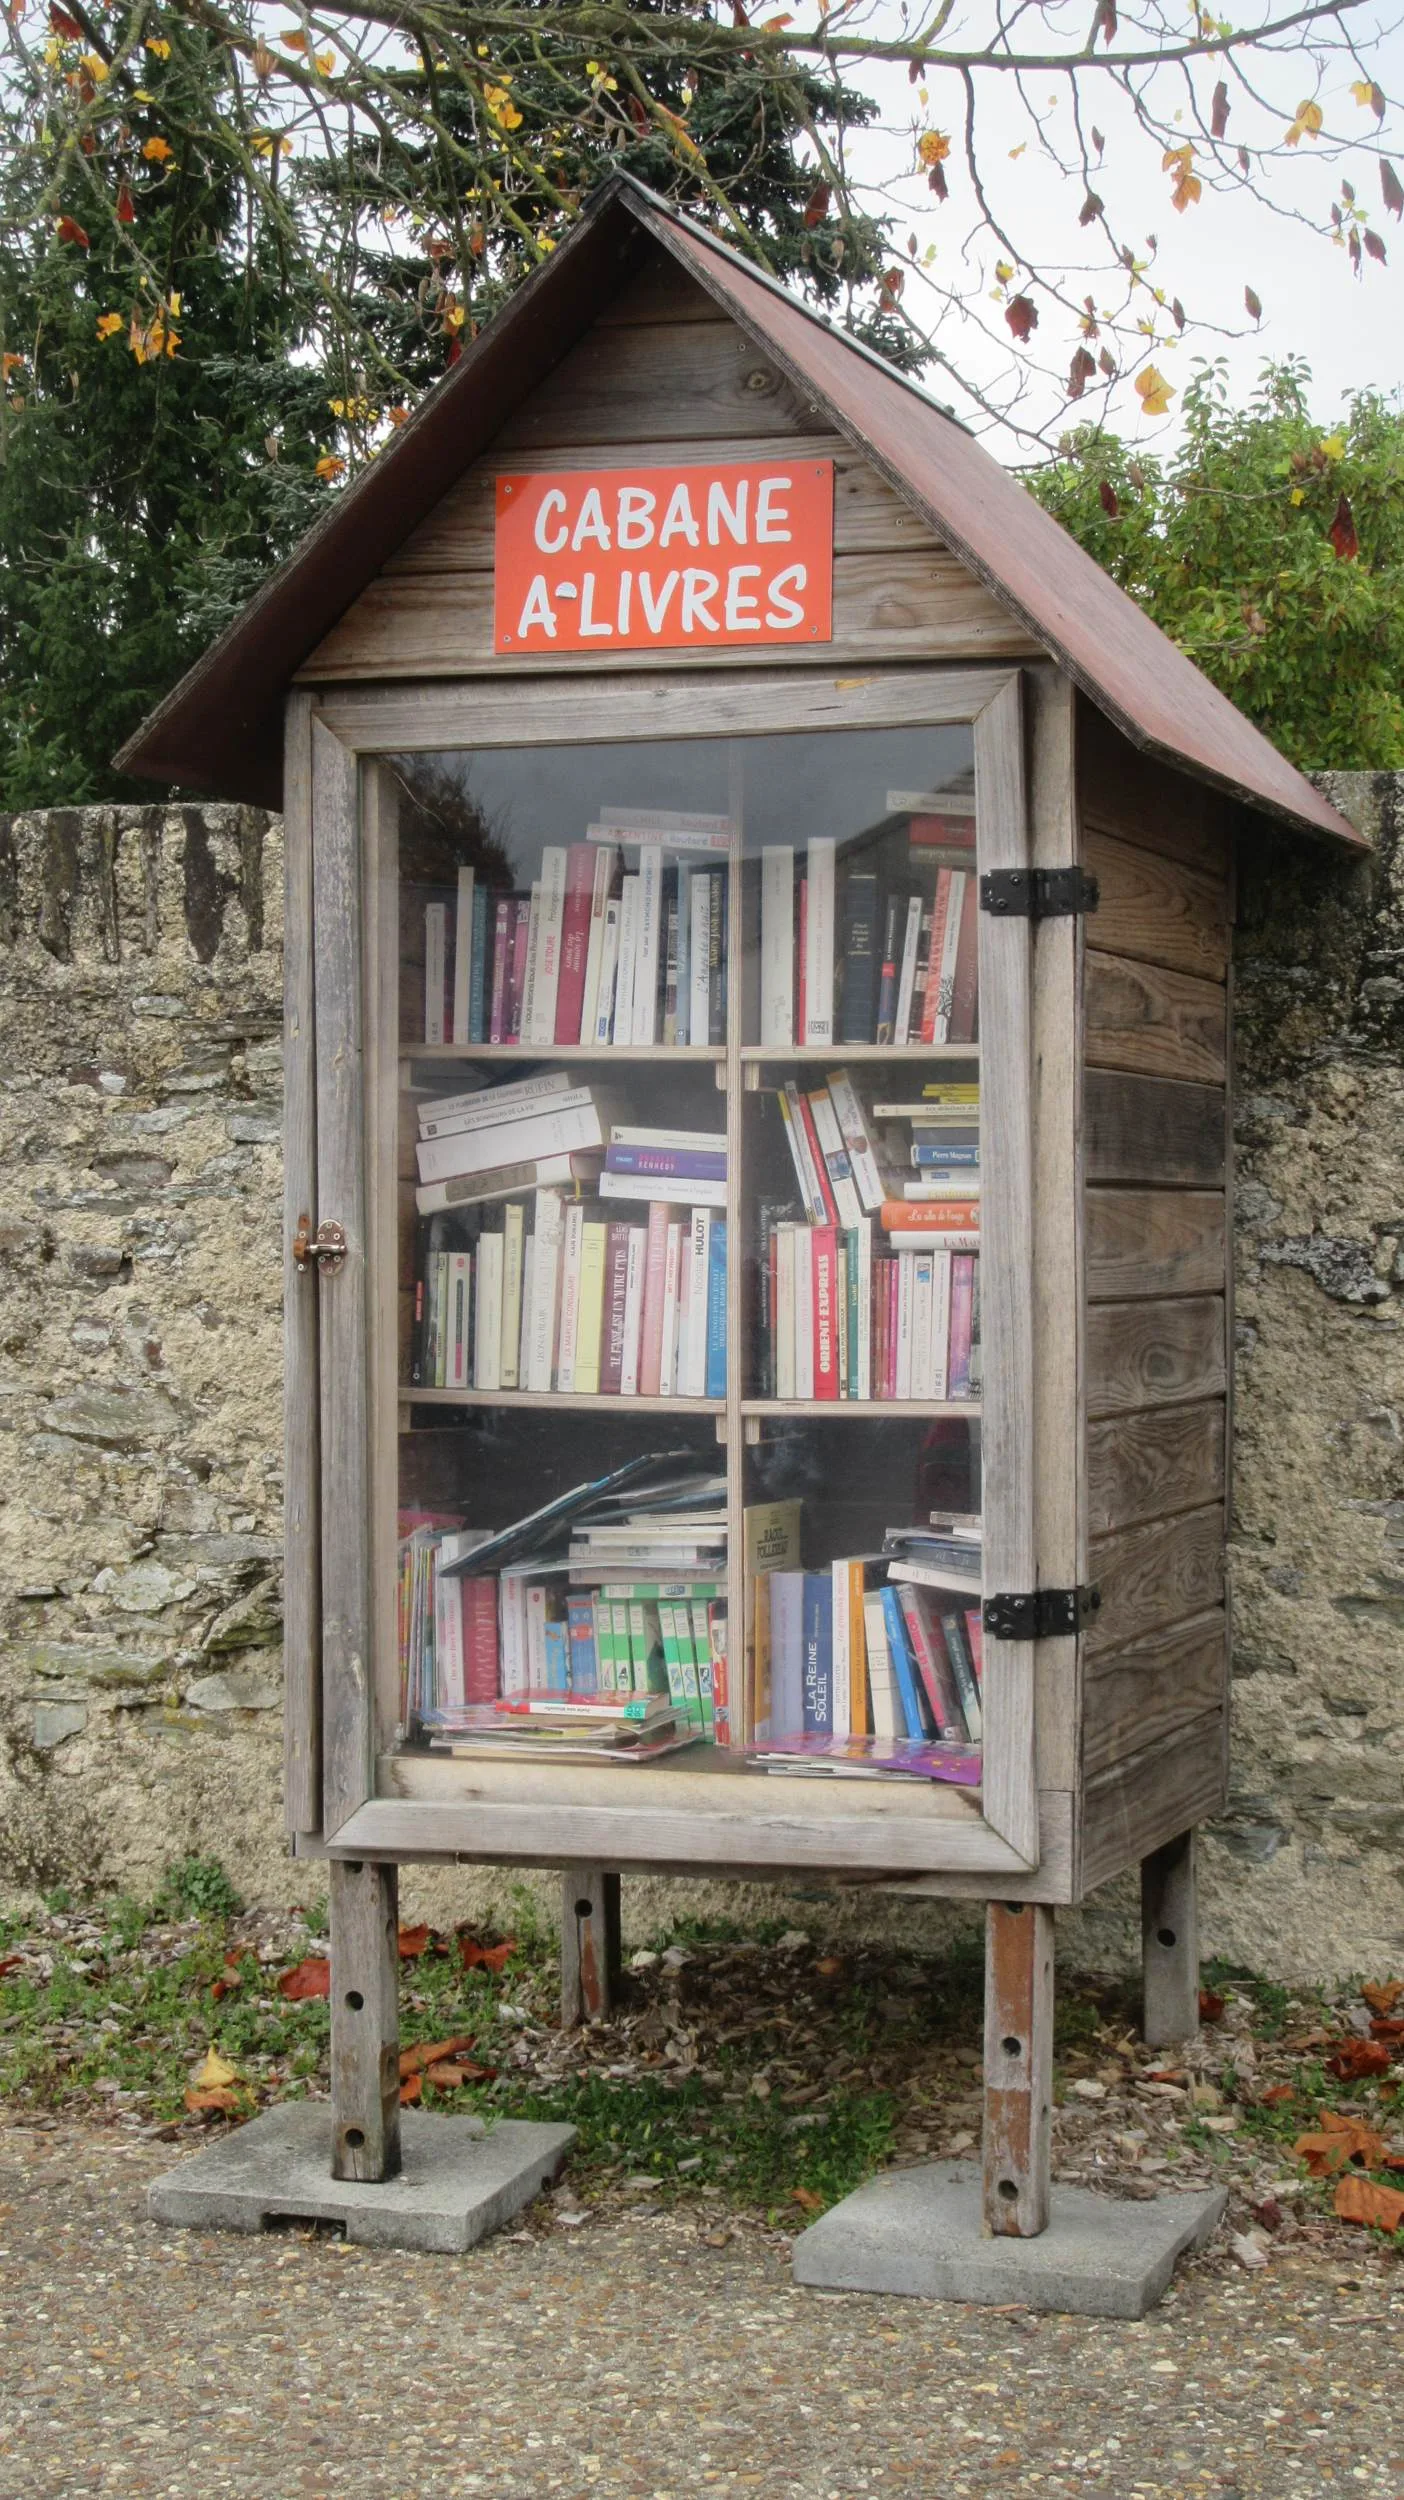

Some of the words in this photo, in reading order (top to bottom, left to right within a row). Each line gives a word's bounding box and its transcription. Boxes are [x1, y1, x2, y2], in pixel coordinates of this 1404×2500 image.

[534, 477, 792, 554] CABANE
[638, 1161, 674, 1170] KENNEDY
[695, 1217, 704, 1255] HULOT
[817, 1254, 829, 1315] EXPRESS
[818, 1319, 830, 1372] ORIENT
[805, 1641, 816, 1685] REINE
[806, 1690, 816, 1709] LA
[815, 1672, 826, 1721] SOLEIL
